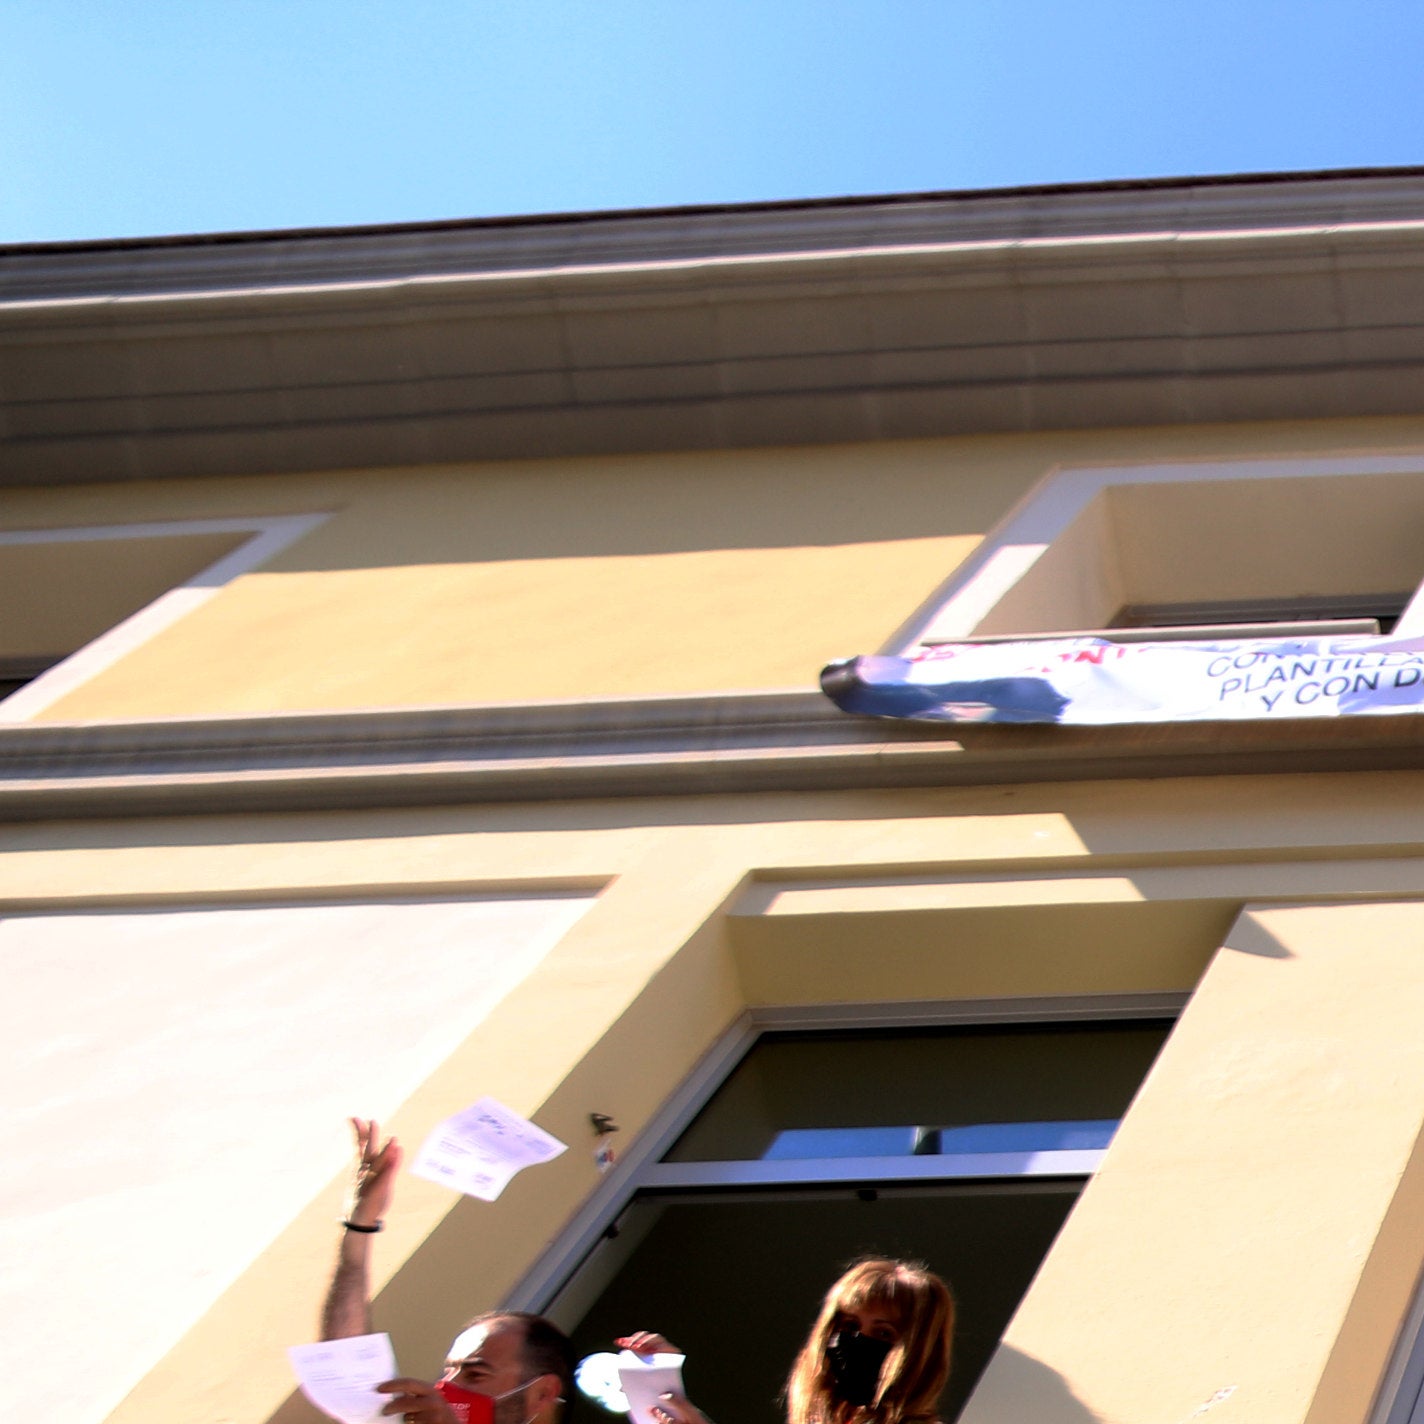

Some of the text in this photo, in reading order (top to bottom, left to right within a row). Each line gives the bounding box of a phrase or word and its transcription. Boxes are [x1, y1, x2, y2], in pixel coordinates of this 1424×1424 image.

[1219, 656, 1424, 701] PLANTILLA
[1260, 690, 1284, 712] Y
[1295, 672, 1380, 704] CON
